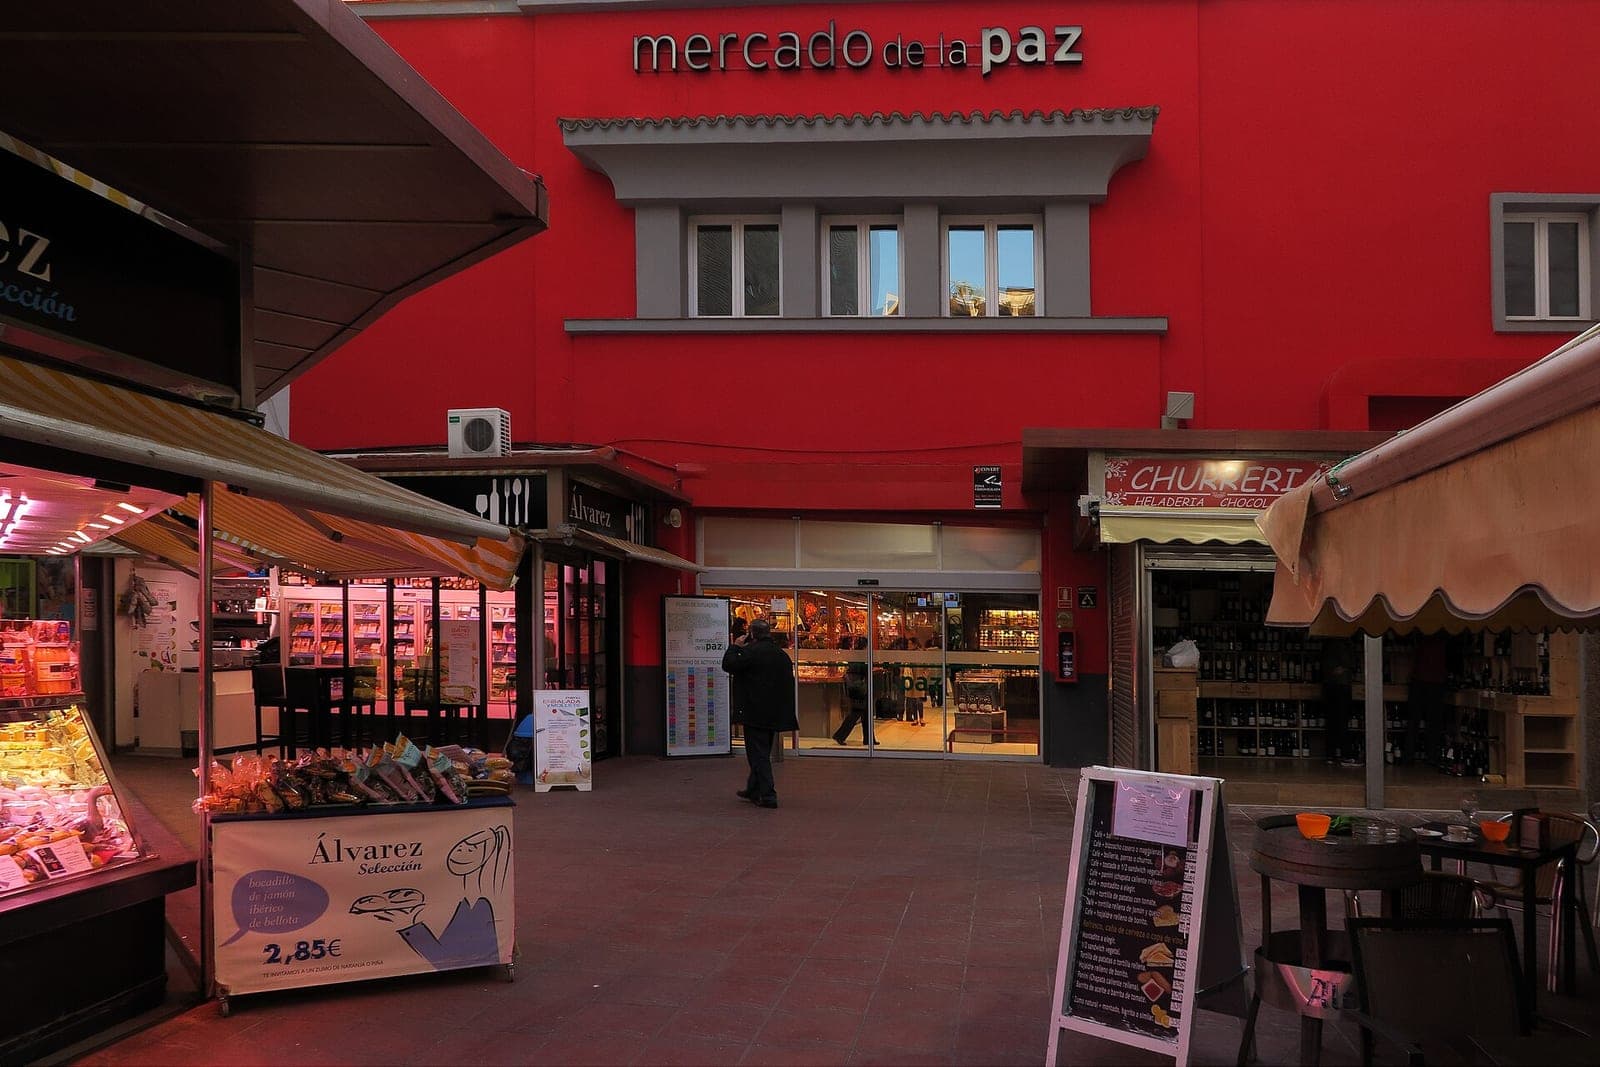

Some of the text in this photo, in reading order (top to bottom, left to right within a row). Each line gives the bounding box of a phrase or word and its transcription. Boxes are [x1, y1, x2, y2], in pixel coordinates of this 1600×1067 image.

[632, 19, 1083, 79] mercado de la paz
[568, 484, 611, 528] Álvarez
[1135, 496, 1268, 509] HELADERIA CHOCOL
[706, 643, 722, 652] paz
[308, 832, 423, 865] Álvarez
[357, 860, 423, 876] Selección
[248, 875, 296, 888] bocadillo
[248, 892, 261, 902] de
[248, 918, 262, 929] de
[262, 939, 341, 966] 2,85€
